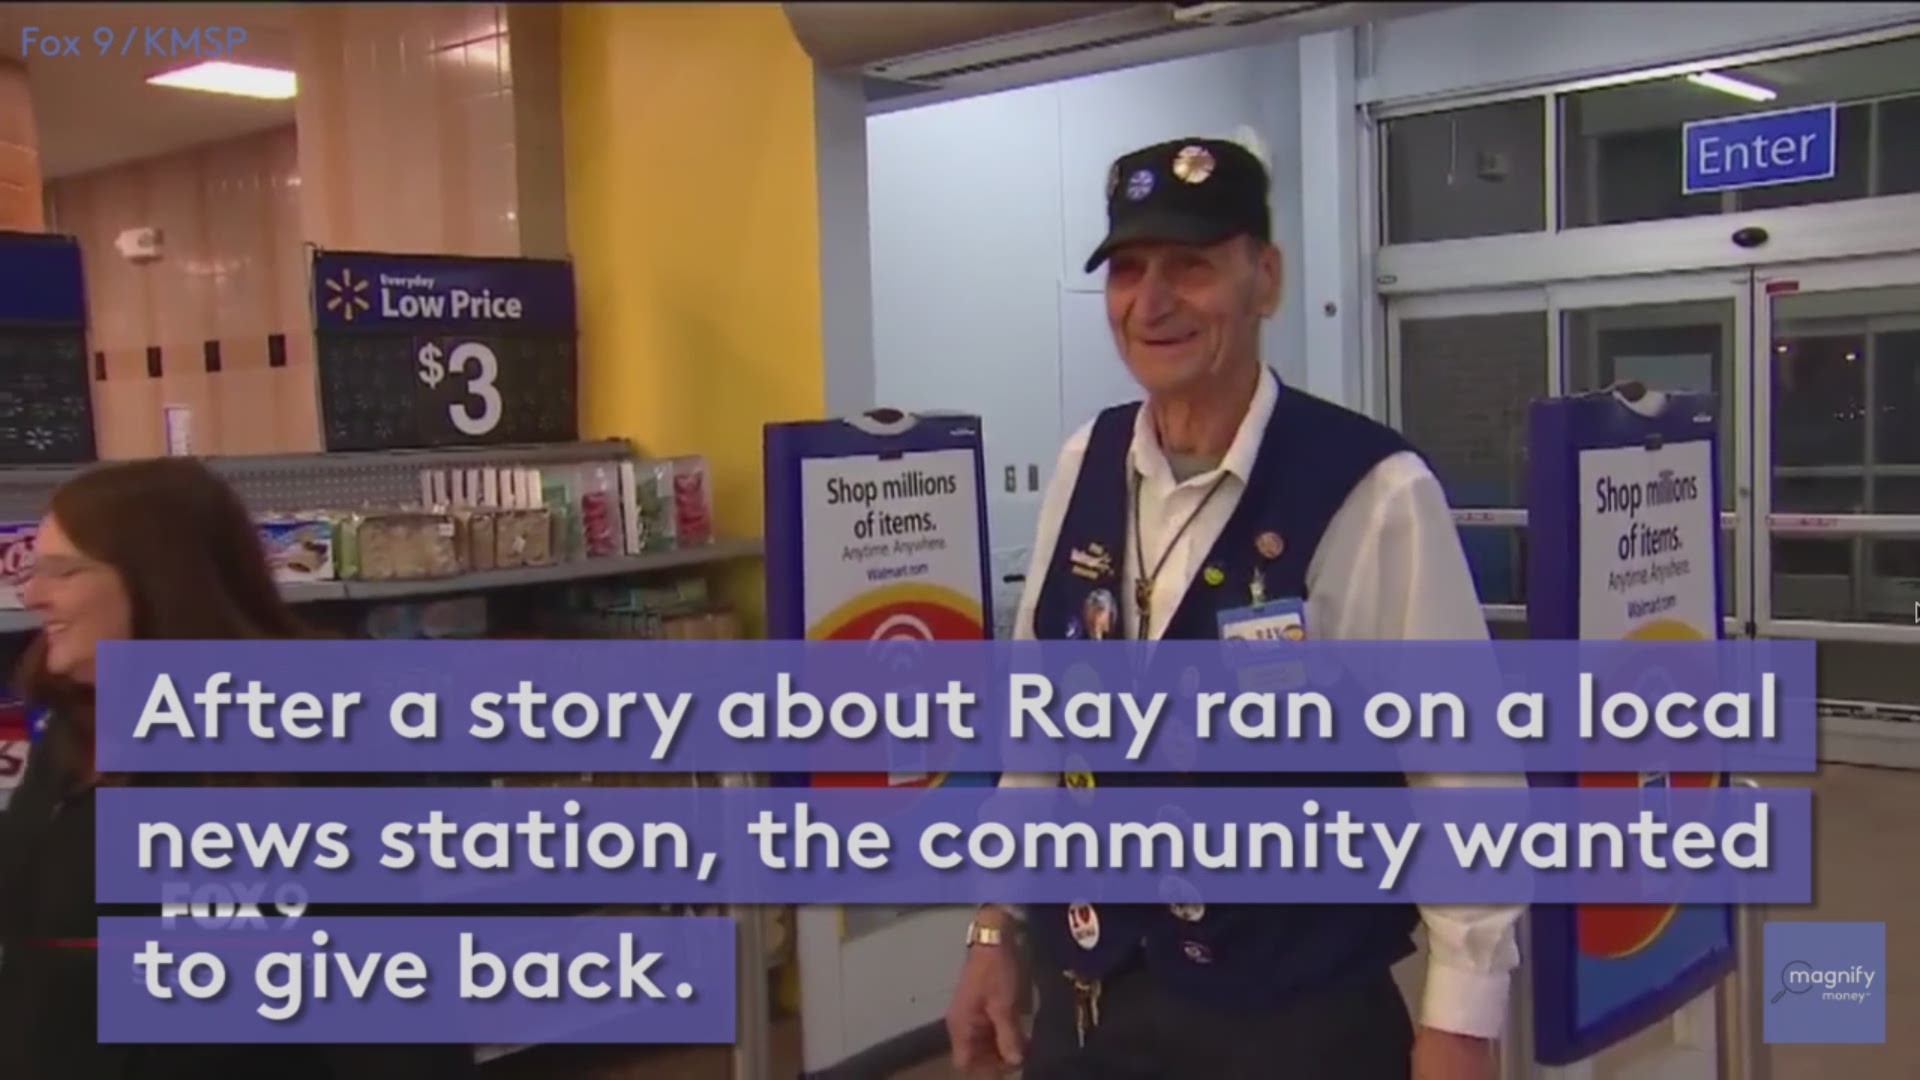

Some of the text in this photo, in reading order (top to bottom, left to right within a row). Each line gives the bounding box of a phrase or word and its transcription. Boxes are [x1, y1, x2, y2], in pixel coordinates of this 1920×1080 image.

[1699, 132, 1817, 175] Enter
[380, 273, 435, 290] Everyday
[381, 288, 522, 319] Low Price
[418, 342, 502, 436] $3
[826, 470, 957, 507] Shop millions
[1596, 476, 1642, 518] Shop
[853, 510, 937, 539] of items.
[1618, 523, 1683, 561] of items.
